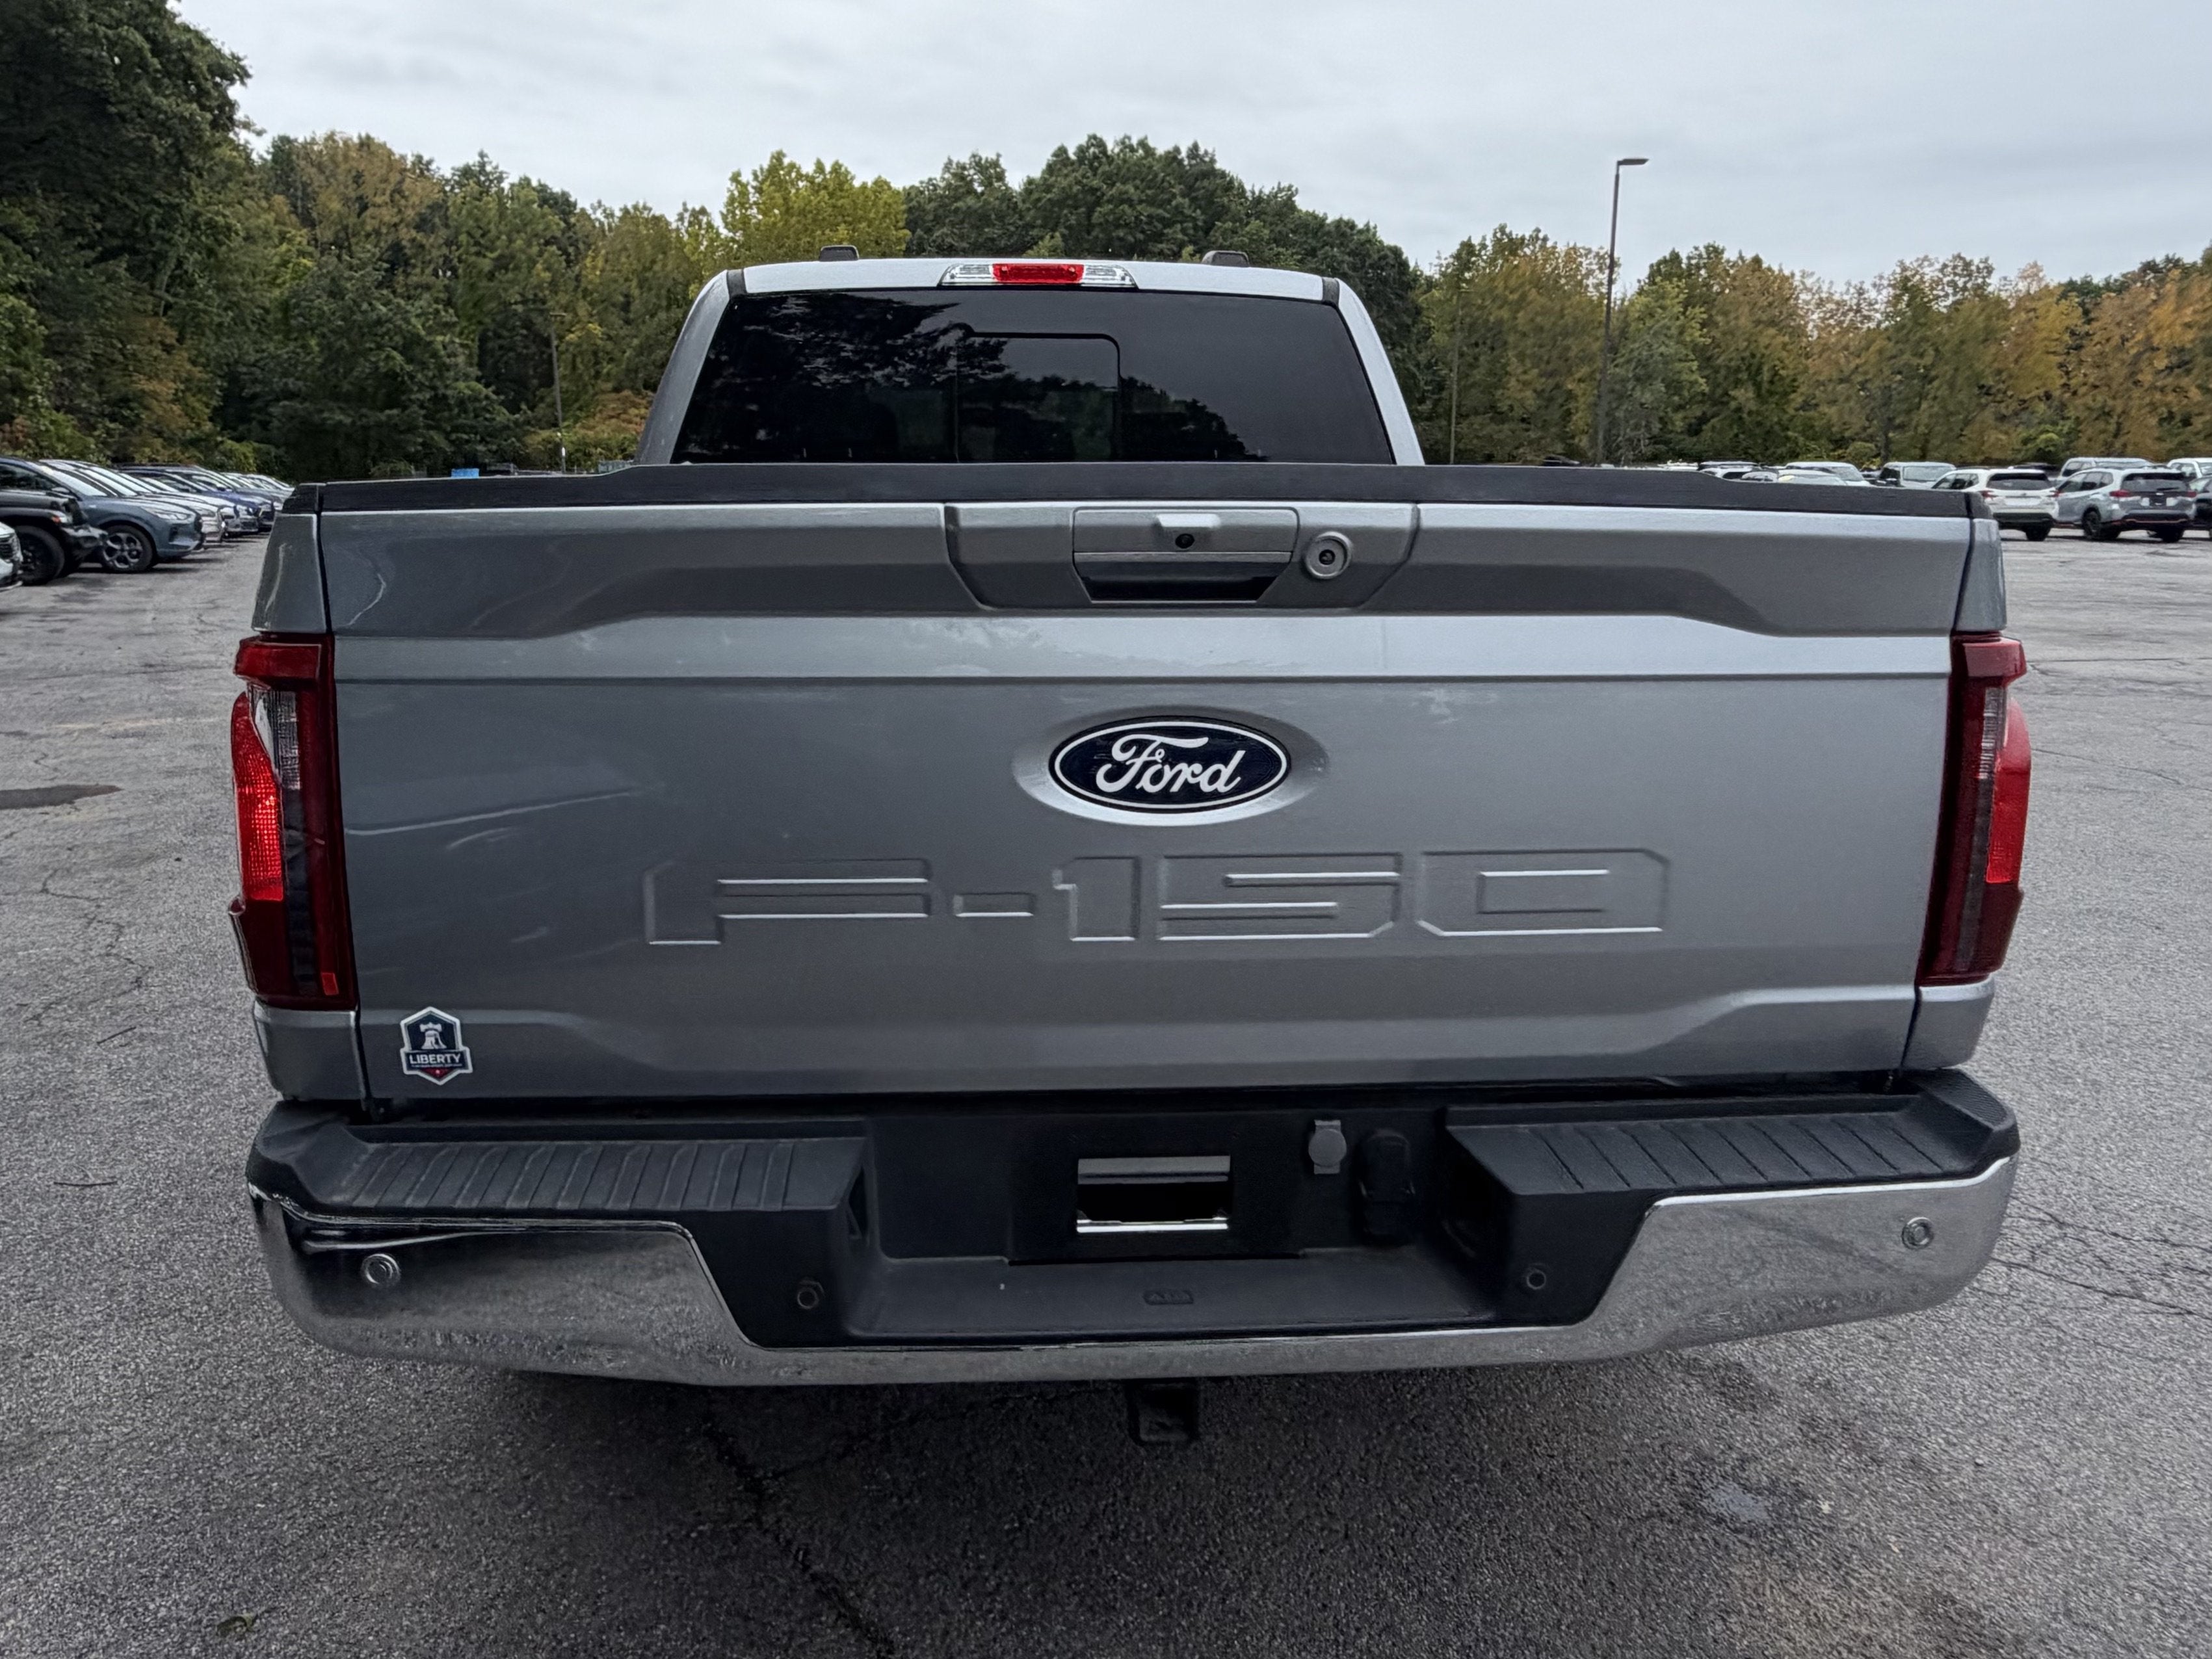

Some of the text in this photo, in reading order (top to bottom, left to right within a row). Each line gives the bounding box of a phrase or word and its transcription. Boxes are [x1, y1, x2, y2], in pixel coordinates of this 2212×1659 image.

[1096, 733, 1246, 793] Ford
[644, 848, 1670, 945] F-150
[409, 1053, 461, 1064] LIBERTY
